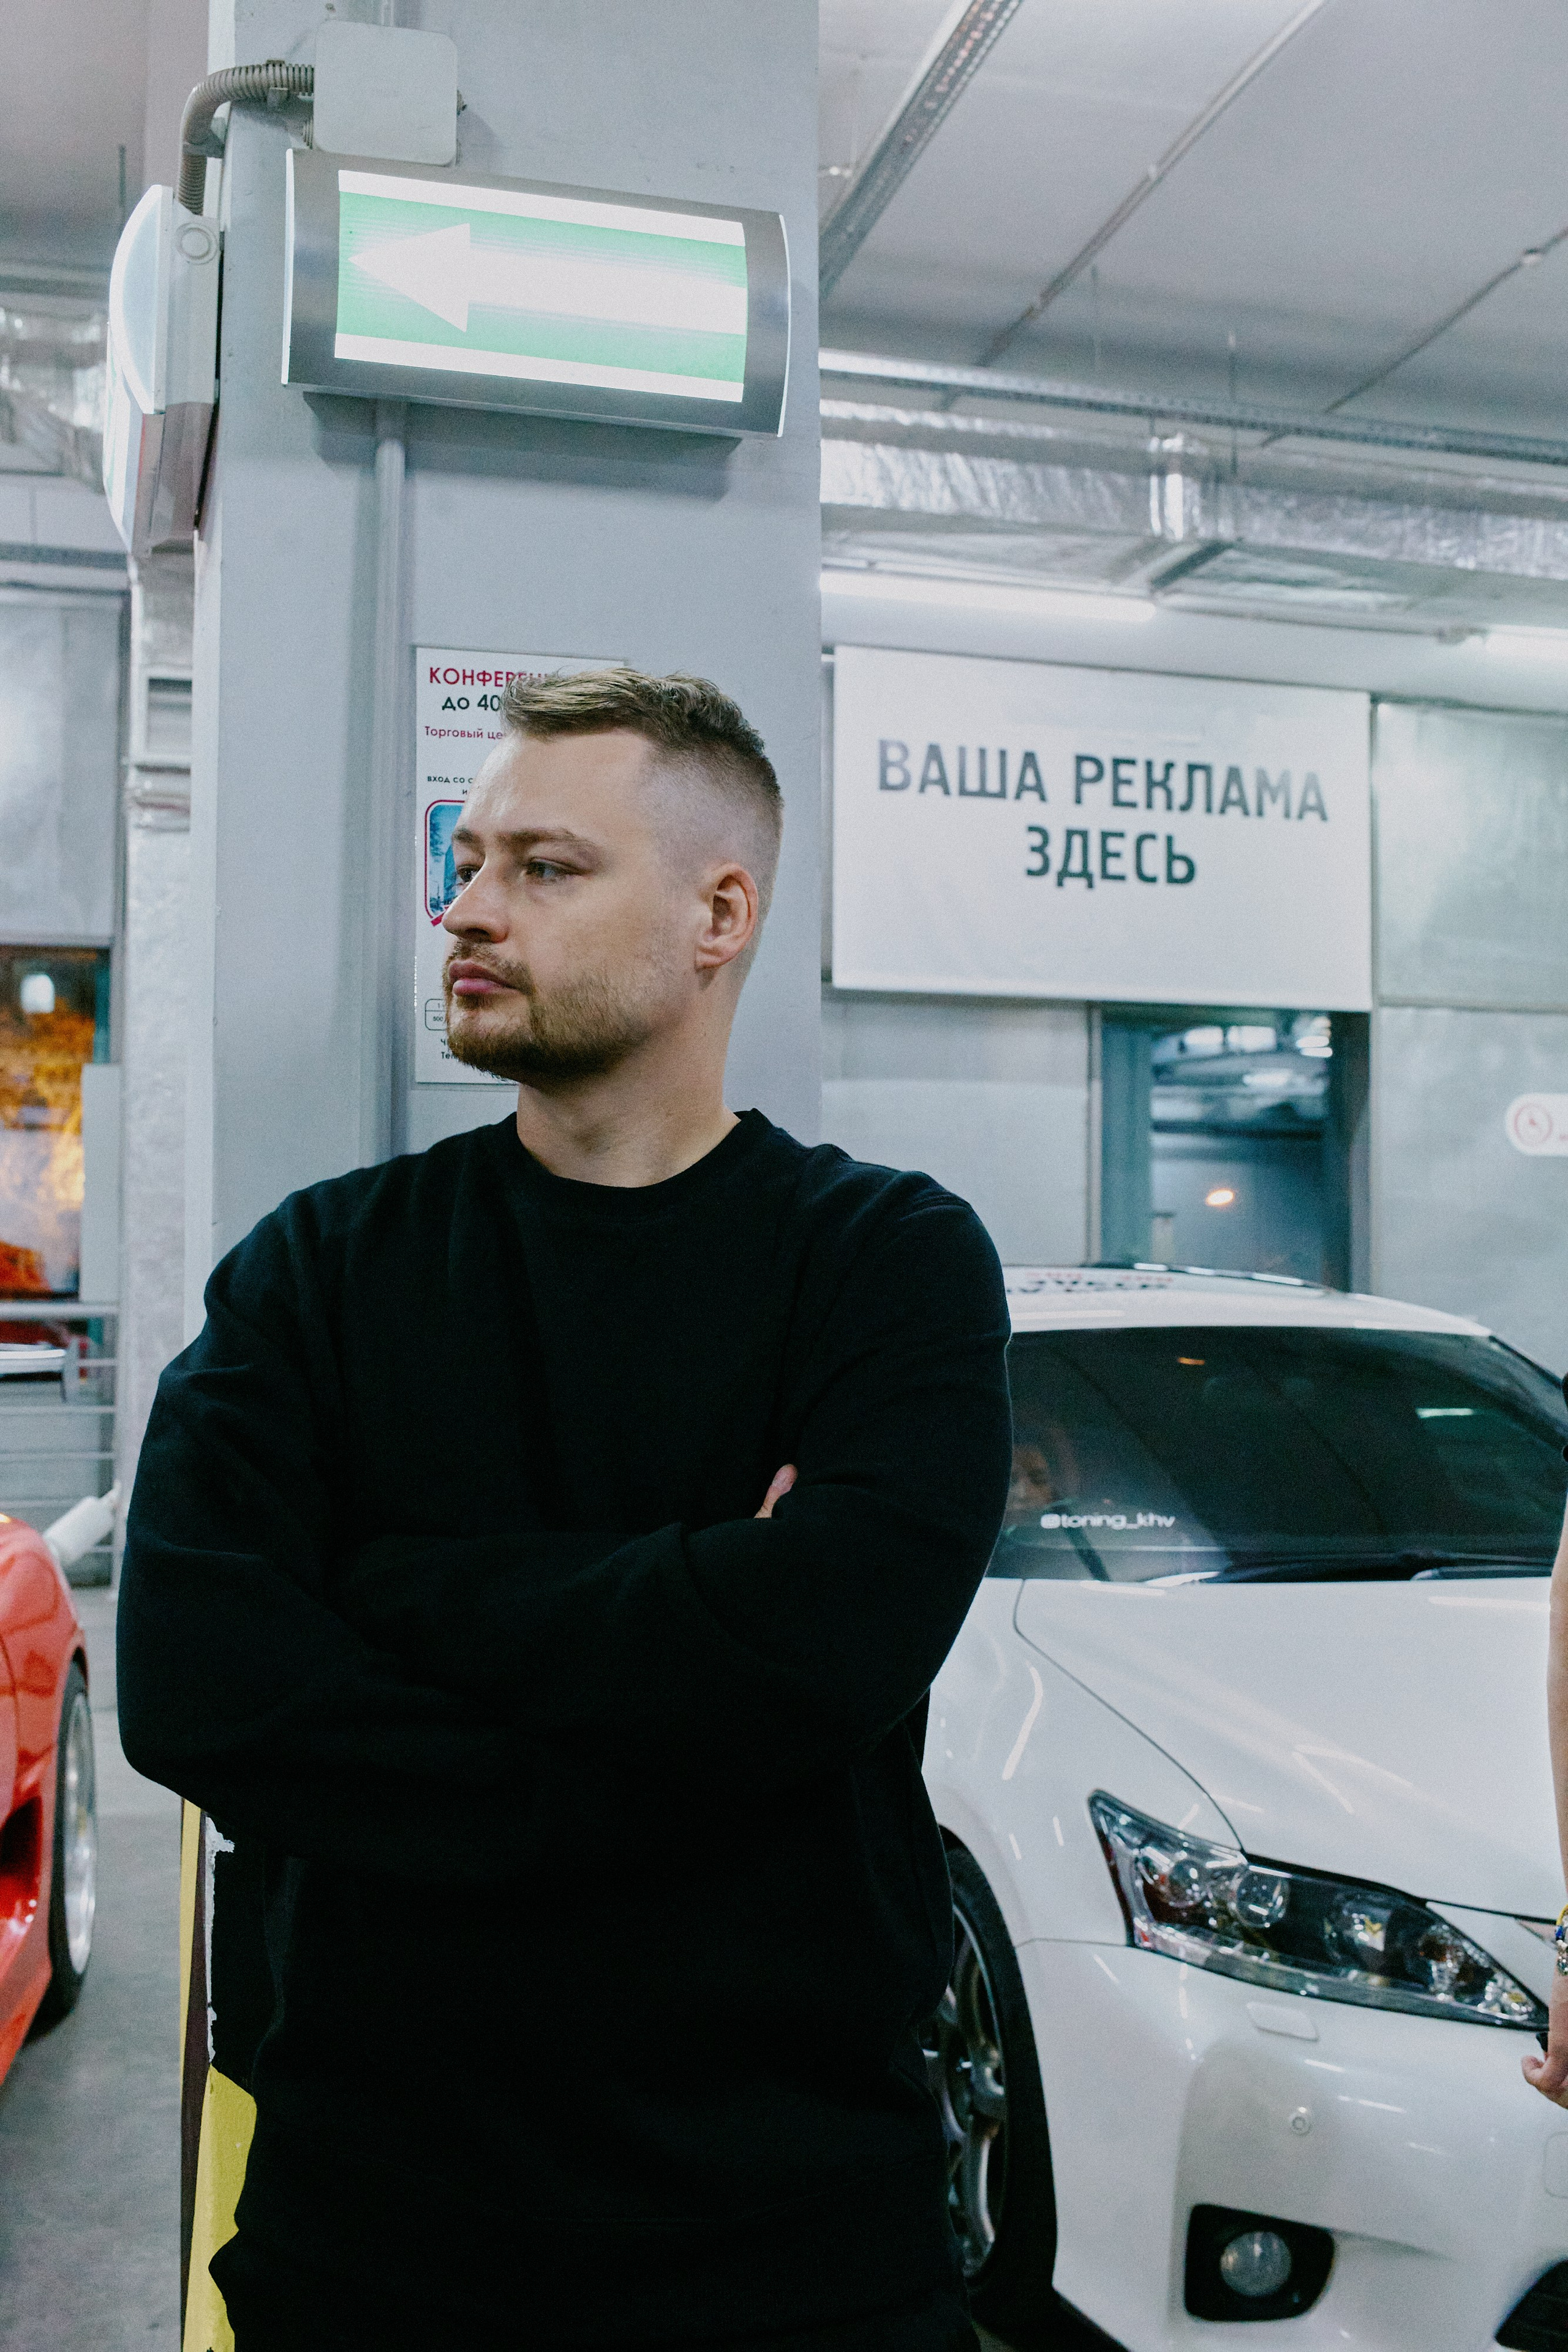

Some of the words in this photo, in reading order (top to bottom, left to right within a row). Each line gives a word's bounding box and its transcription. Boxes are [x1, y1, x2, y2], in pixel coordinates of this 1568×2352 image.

[429, 667, 548, 687] КОНФЕР
[477, 693, 502, 712] 40
[424, 726, 483, 739] Торговый
[878, 738, 1047, 803] ВАША
[1074, 754, 1329, 821] РЕКЛАМА
[1027, 826, 1195, 889] ЗДЕСЬ
